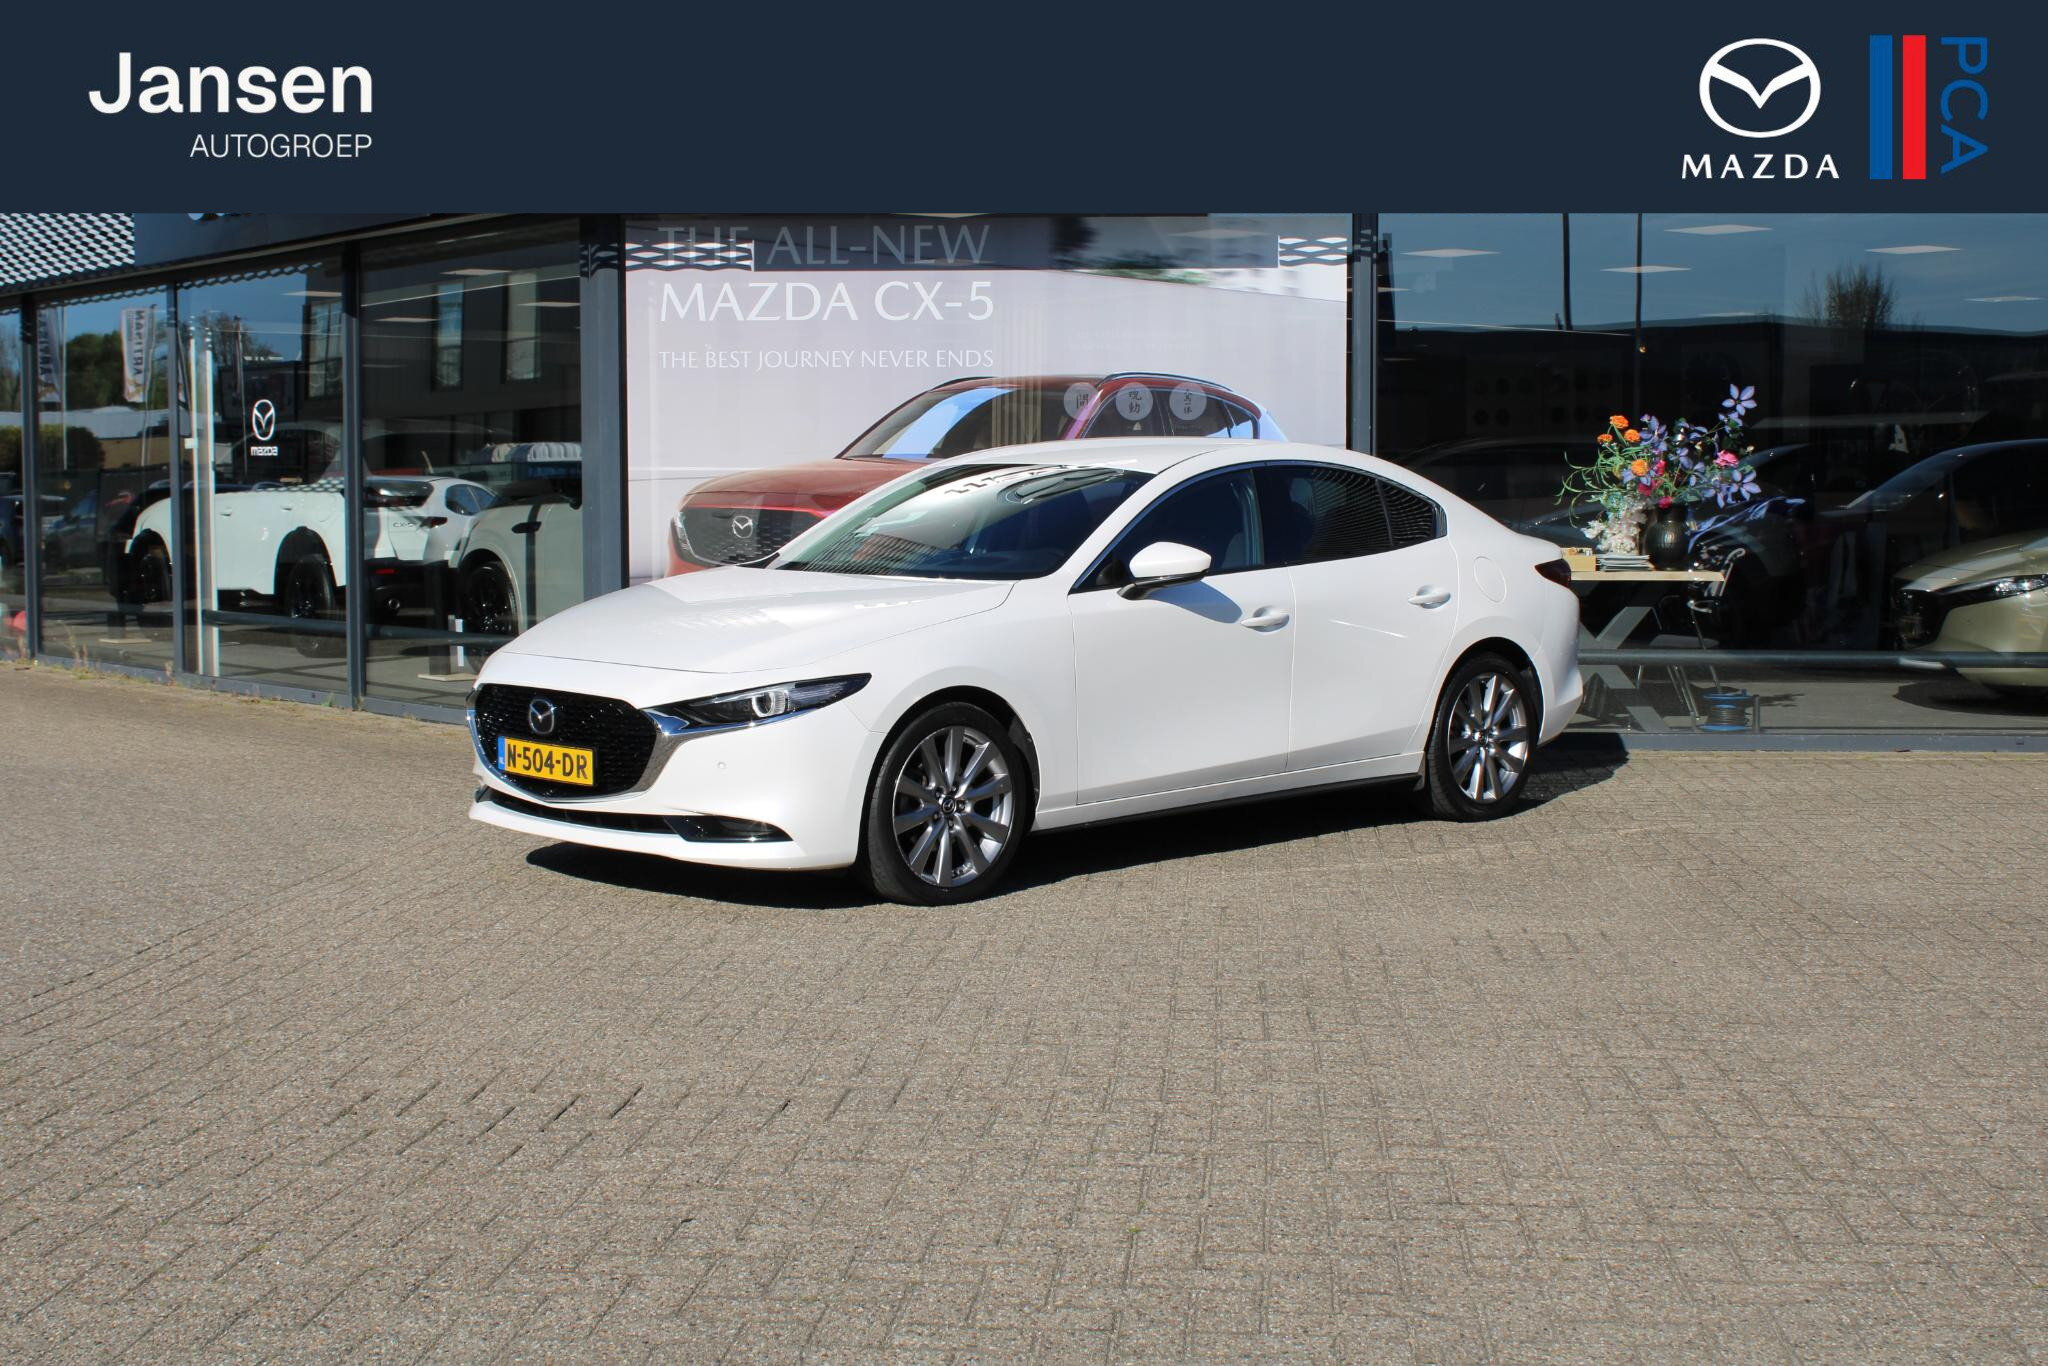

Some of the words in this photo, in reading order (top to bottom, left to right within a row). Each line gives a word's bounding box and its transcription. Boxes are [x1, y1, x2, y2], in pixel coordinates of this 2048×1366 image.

[657, 226, 749, 264] THE
[766, 224, 991, 265] ALL-NEW
[660, 281, 859, 321] MAZDA
[874, 280, 994, 321] CX-5
[658, 350, 698, 368] THE
[704, 350, 752, 368] BEST
[754, 350, 855, 374] JOURNEY
[861, 349, 930, 368] NEVER
[936, 350, 994, 368] ENDS
[507, 743, 588, 780] N-504-DR
